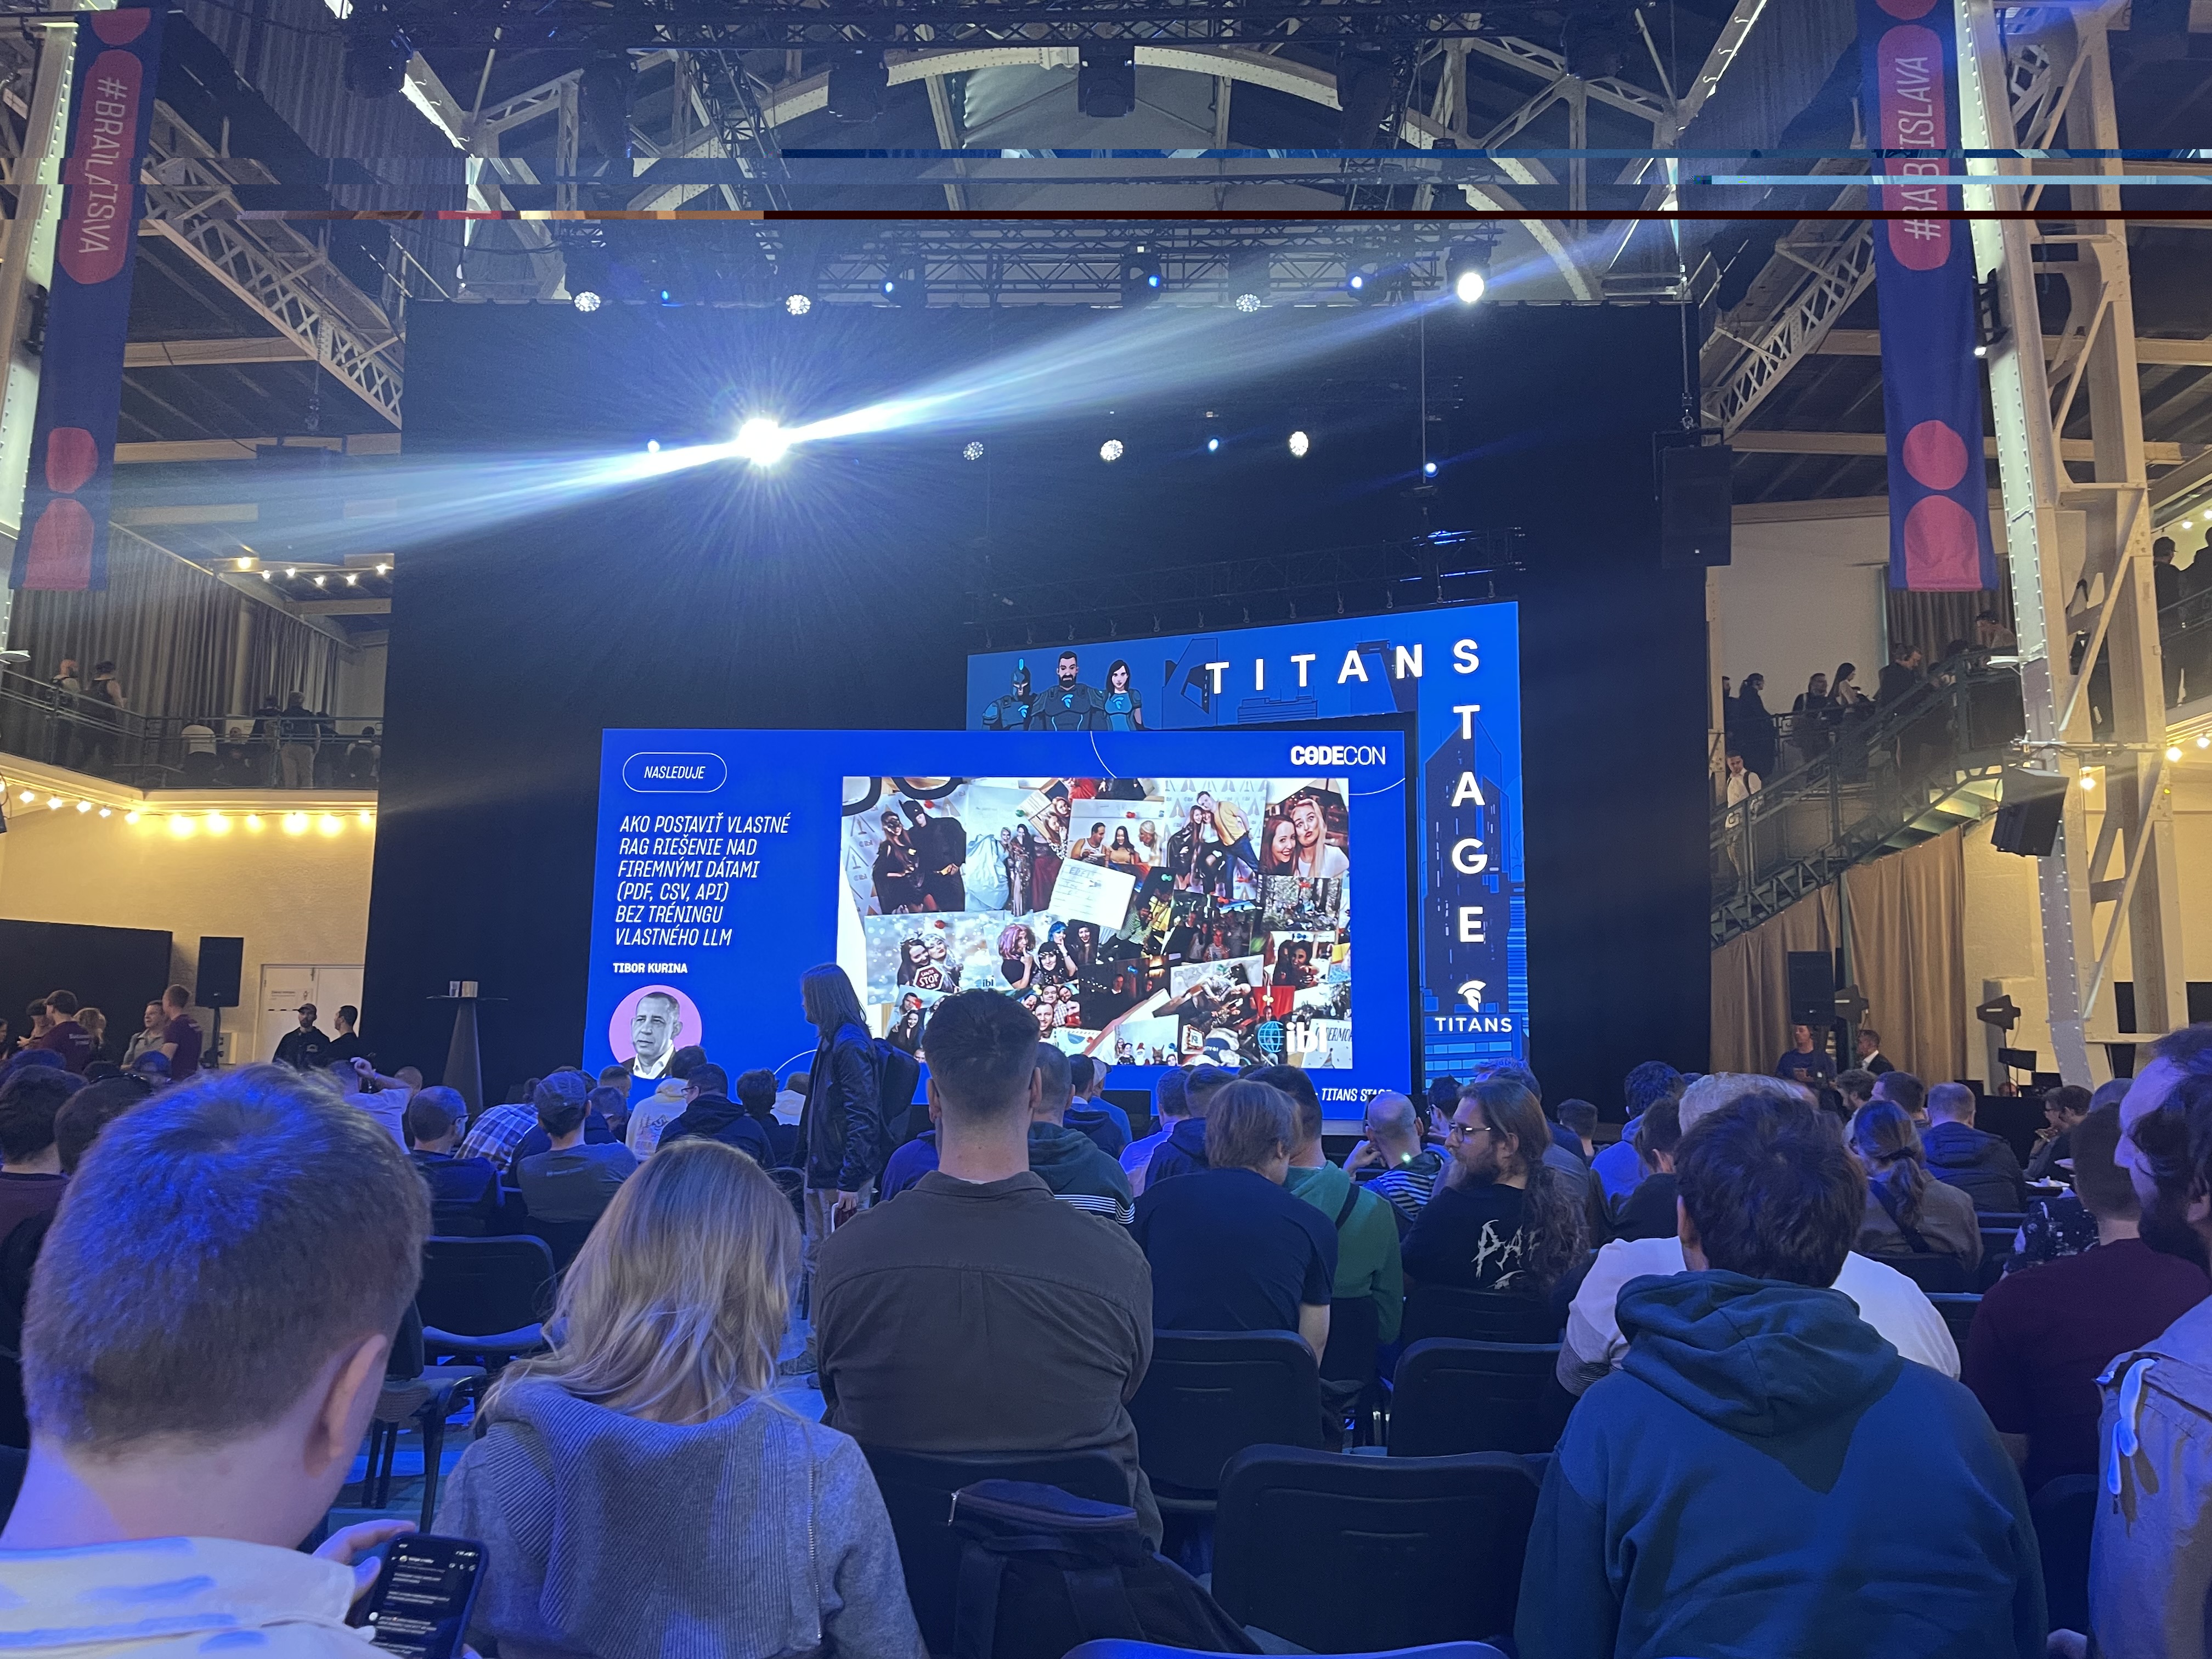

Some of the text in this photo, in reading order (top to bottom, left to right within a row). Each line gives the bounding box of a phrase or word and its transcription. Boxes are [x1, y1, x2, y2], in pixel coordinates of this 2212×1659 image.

[1205, 639, 1480, 696] TITANS
[1291, 746, 1386, 765] CODECON
[644, 766, 706, 779] NASLEDUJE
[619, 812, 791, 833] AKO POSTAVIŤ VLASTNÉ
[619, 834, 757, 855] RAG RIEŠENIE NAD
[618, 857, 760, 878] FIREMNÝMI DÁTAMI
[617, 881, 729, 902] (PDF, CSV, API)
[616, 902, 723, 923] BEZ TRÉNINGU
[616, 924, 732, 946] VLASTNÉHO LLM
[613, 962, 688, 973] TIBOR KURINA
[919, 973, 939, 986] STOP
[1435, 1017, 1512, 1032] TITANS
[1286, 1022, 1327, 1053] ibl
[1322, 1088, 1357, 1102] TITANS
